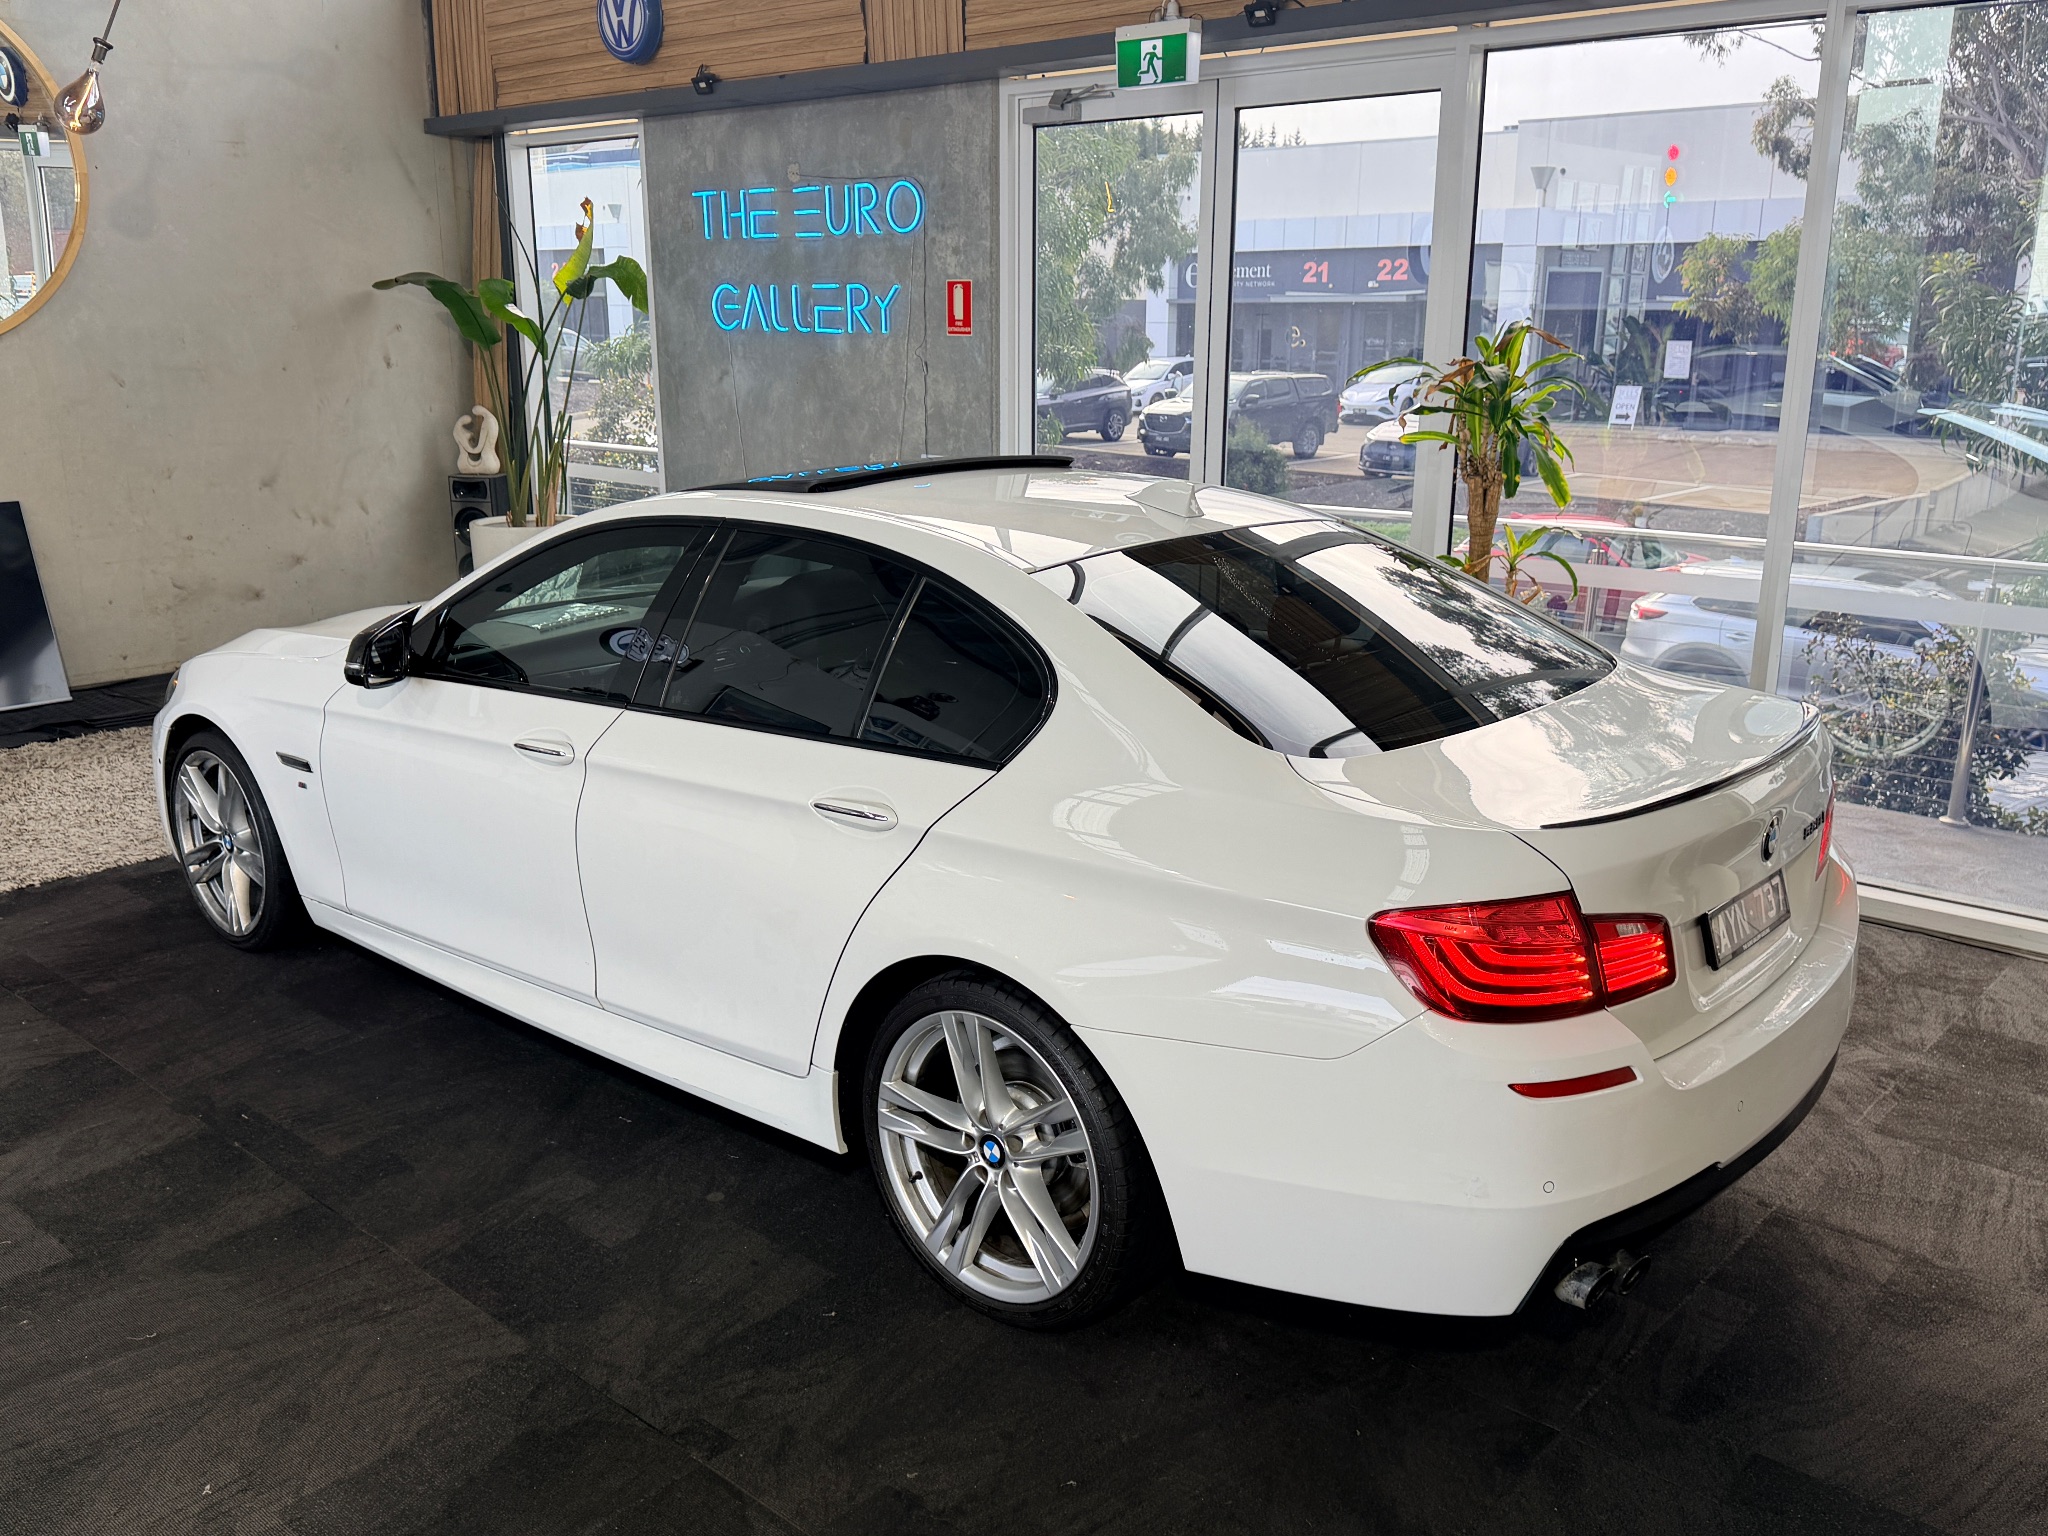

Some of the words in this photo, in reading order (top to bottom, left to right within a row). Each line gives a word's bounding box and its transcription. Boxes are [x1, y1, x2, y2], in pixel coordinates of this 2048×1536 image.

[691, 187, 779, 239] THE
[792, 180, 923, 237] EURO
[1234, 264, 1272, 279] ment
[1302, 261, 1329, 283] 21
[1376, 258, 1409, 281] 22
[711, 283, 900, 334] GALLERY
[1615, 403, 1635, 411] OPEN
